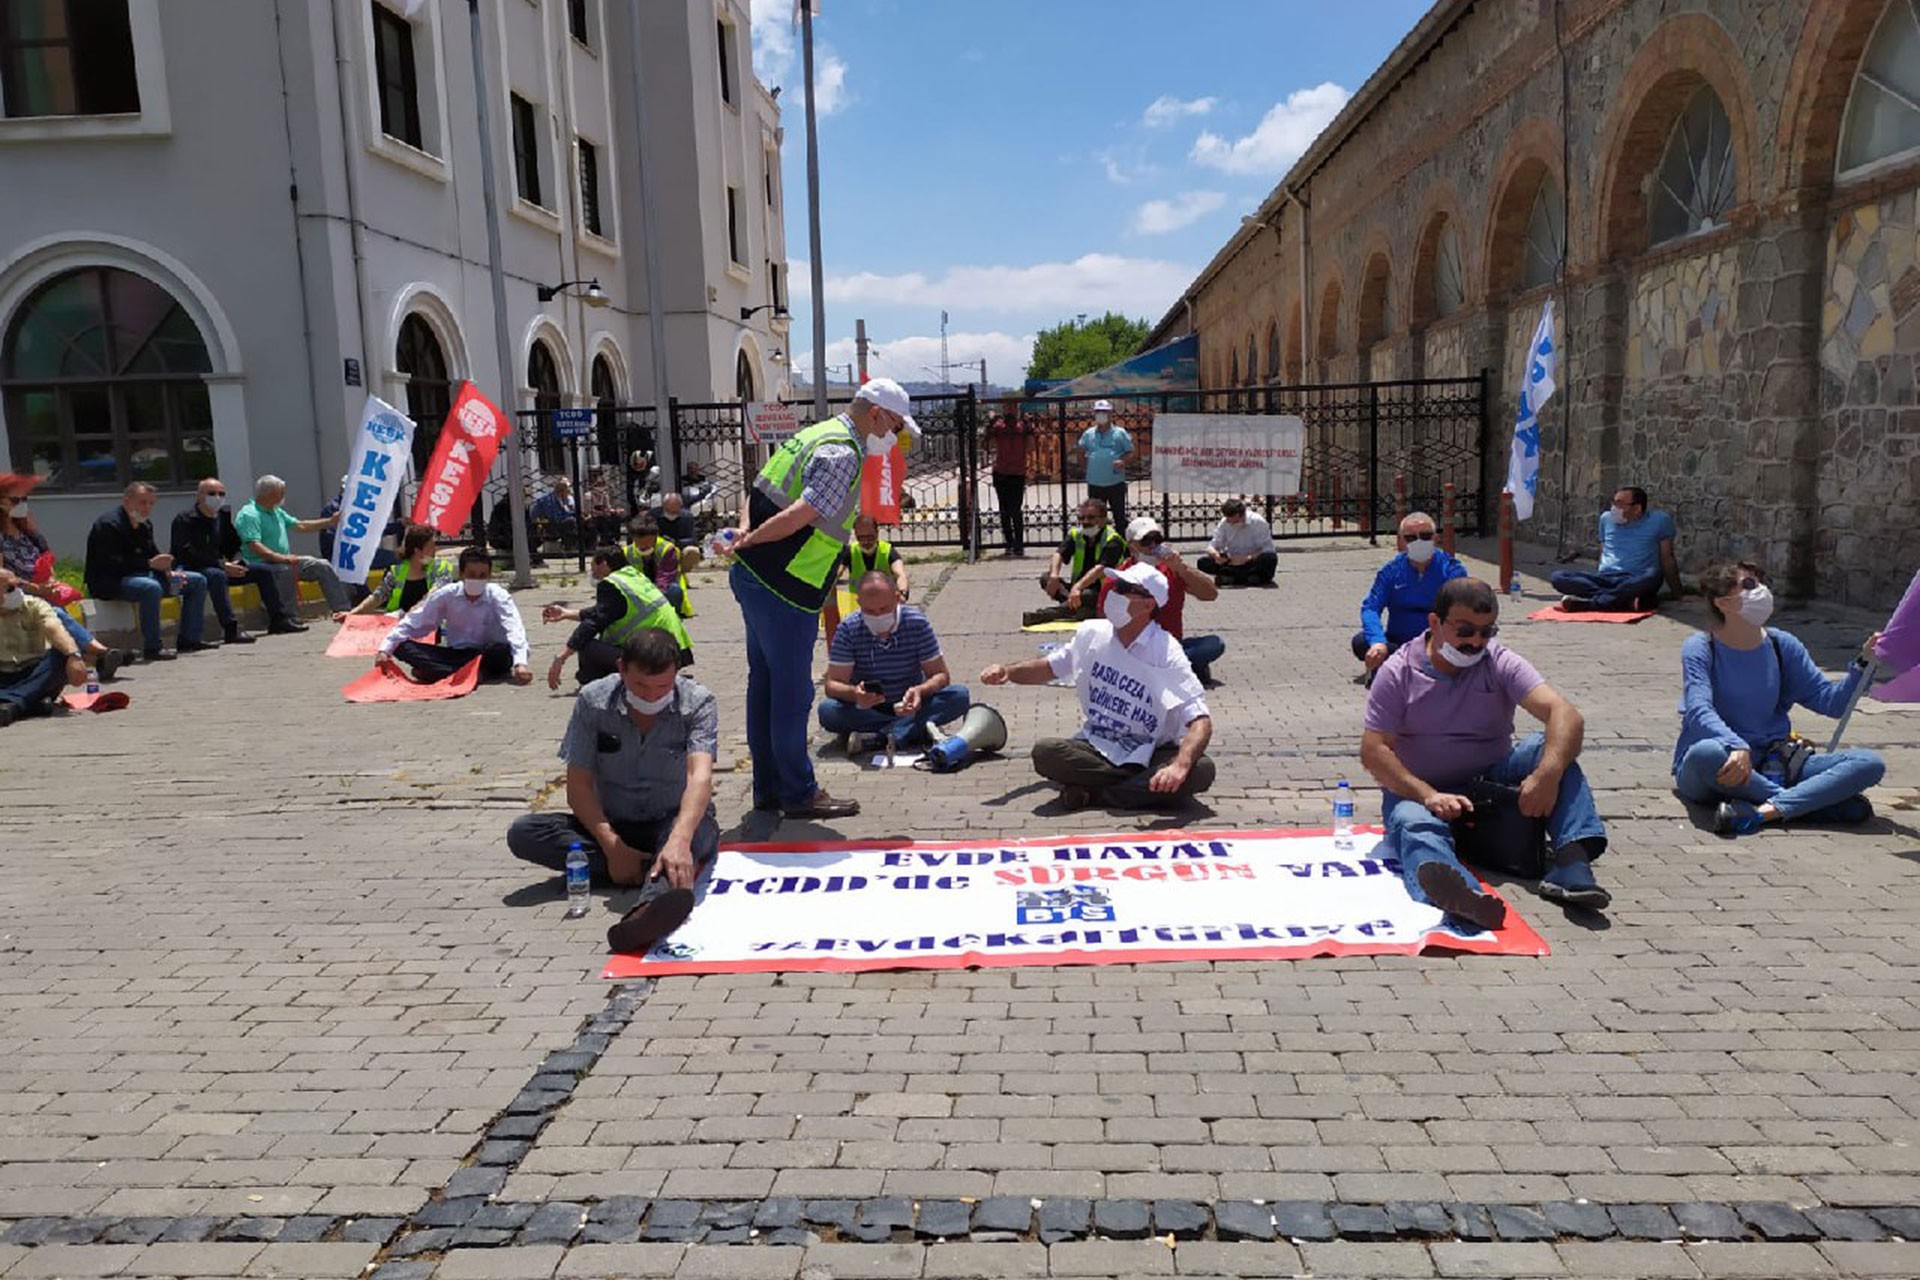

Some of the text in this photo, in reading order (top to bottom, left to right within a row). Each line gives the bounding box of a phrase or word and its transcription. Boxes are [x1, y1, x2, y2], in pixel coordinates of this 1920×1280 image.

[559, 411, 584, 419] TCDD
[366, 421, 406, 441] KESK
[425, 438, 476, 528] KESK
[338, 450, 392, 571] KESK
[1118, 674, 1145, 701] CEZA
[880, 842, 1234, 867] EVDE HAYAT
[994, 861, 1257, 886] SÜRGÜN
[1277, 858, 1404, 878] VAR
[1025, 902, 1108, 922] BTS
